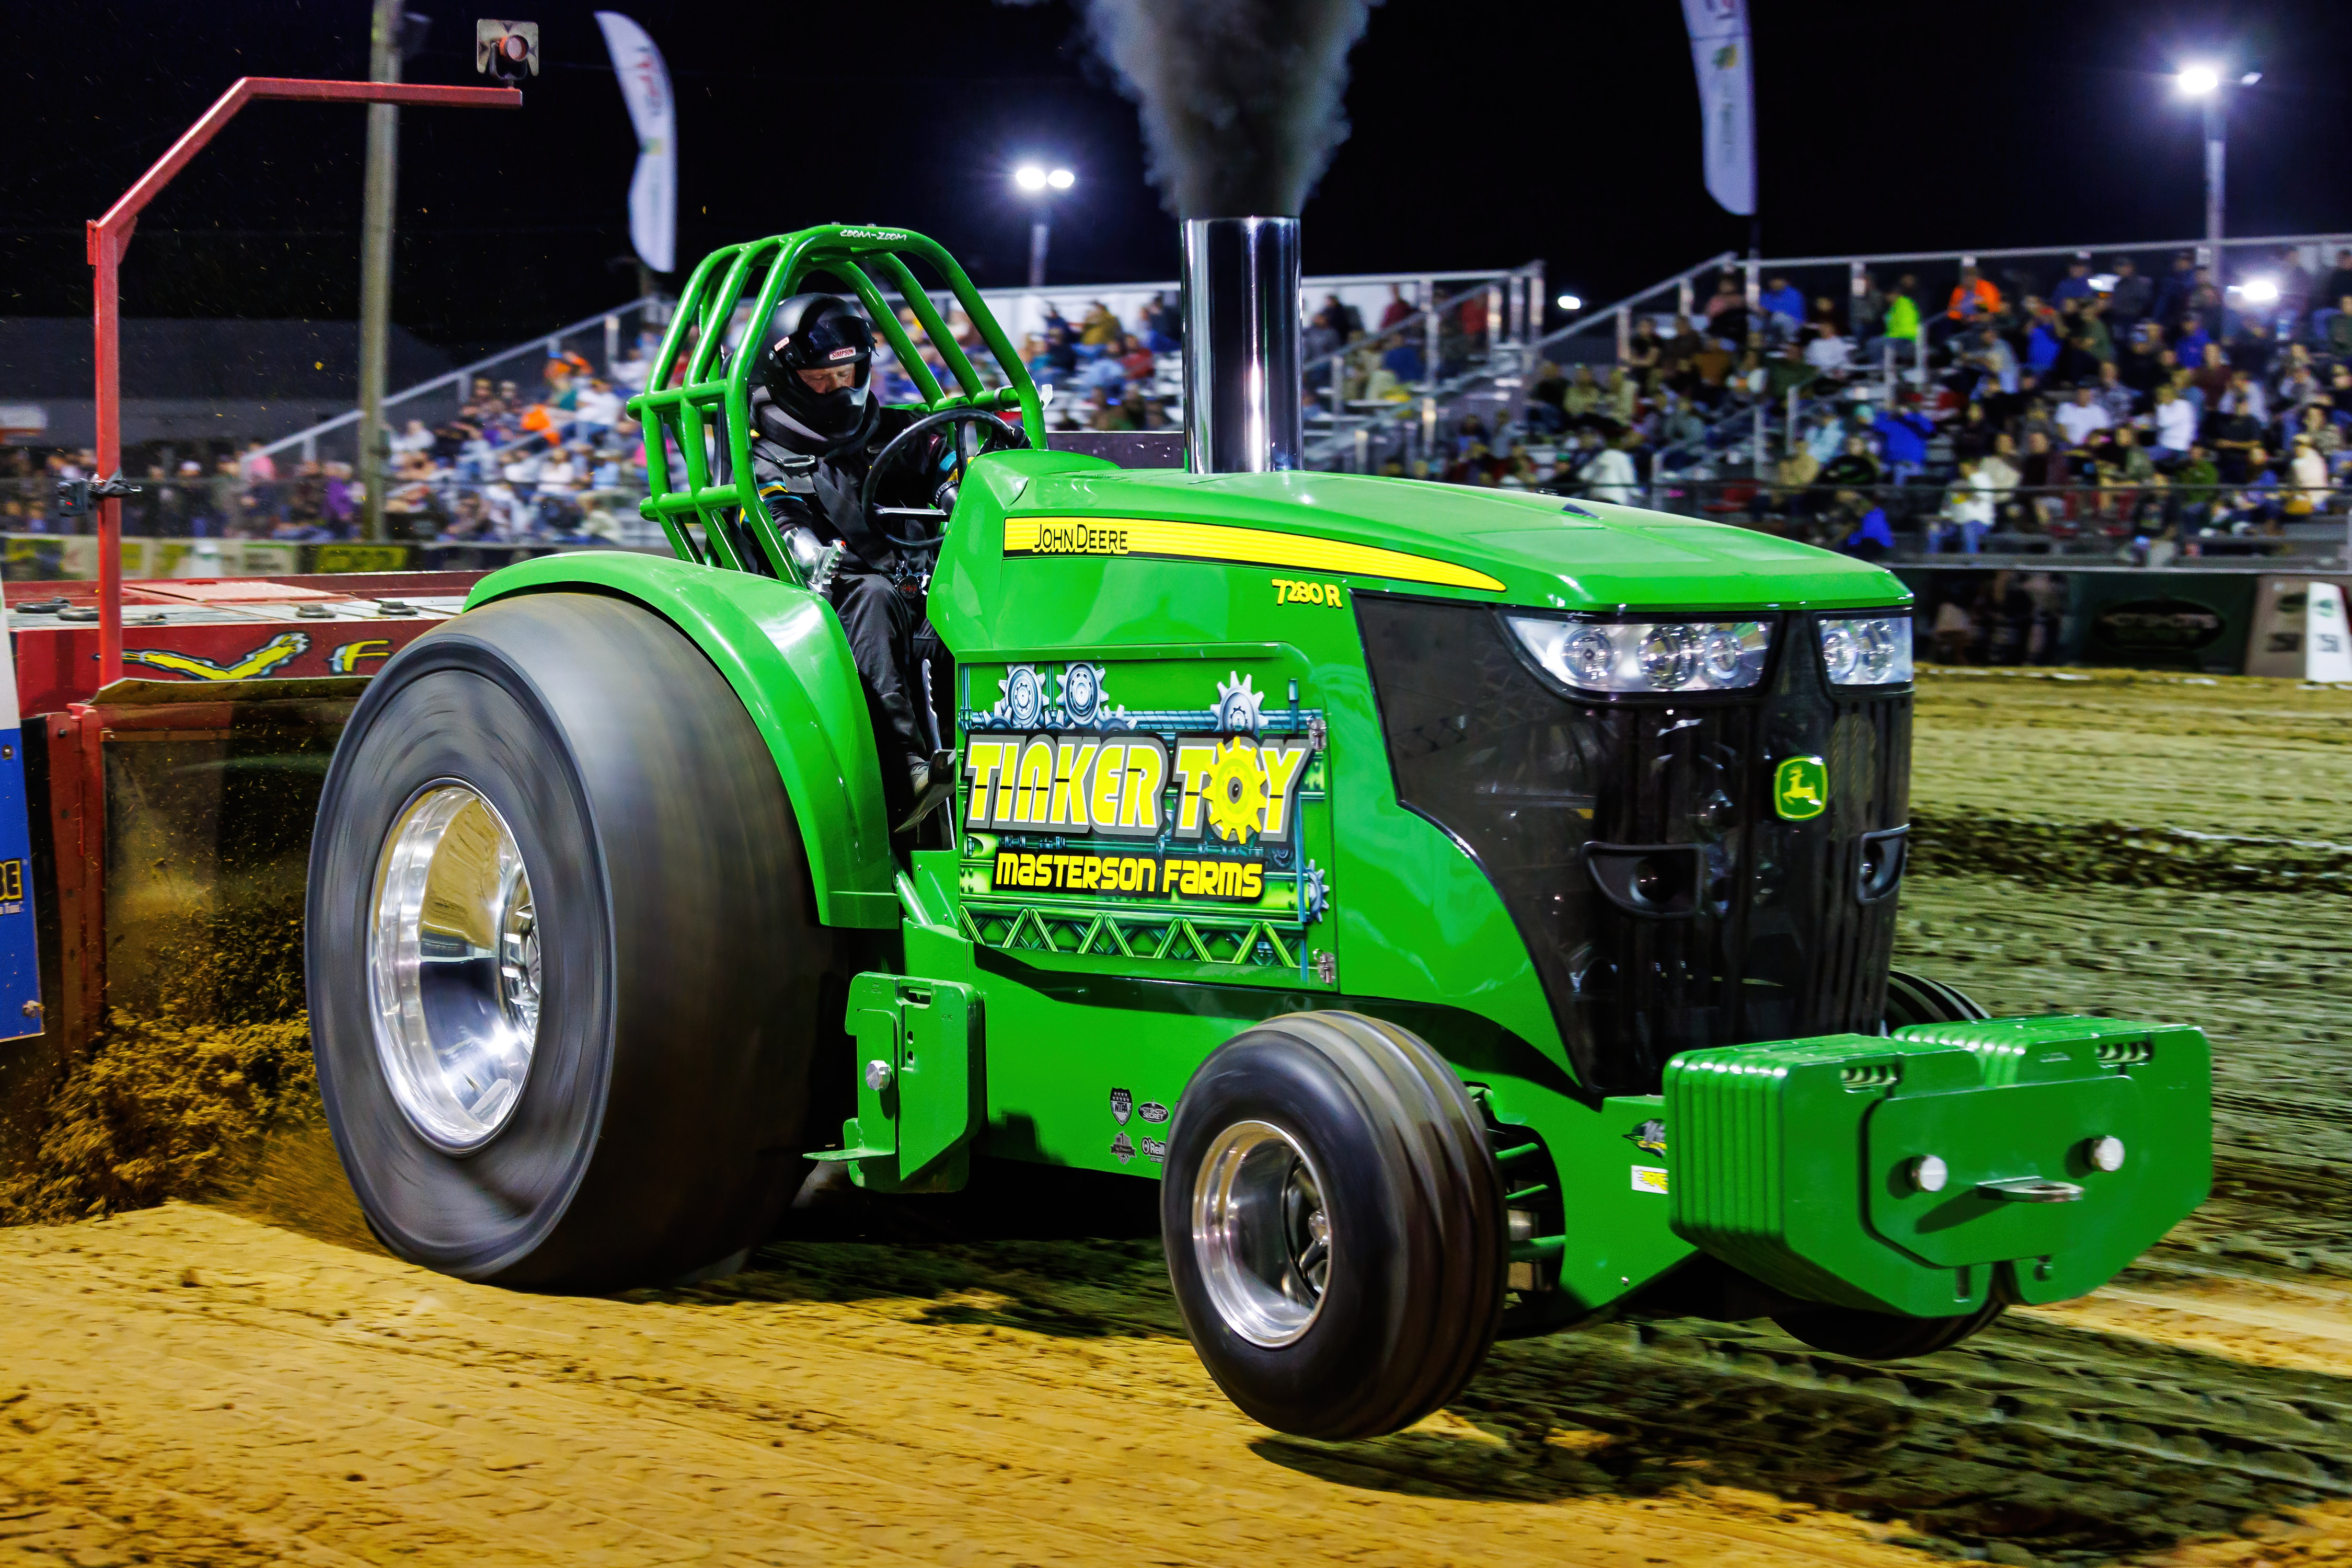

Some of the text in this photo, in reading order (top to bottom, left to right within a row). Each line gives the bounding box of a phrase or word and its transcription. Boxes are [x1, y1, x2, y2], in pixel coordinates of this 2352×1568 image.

[832, 349, 854, 359] SIMPSON
[1034, 524, 1128, 550] JOHN DEERE
[966, 736, 1307, 845] TINKER TOY
